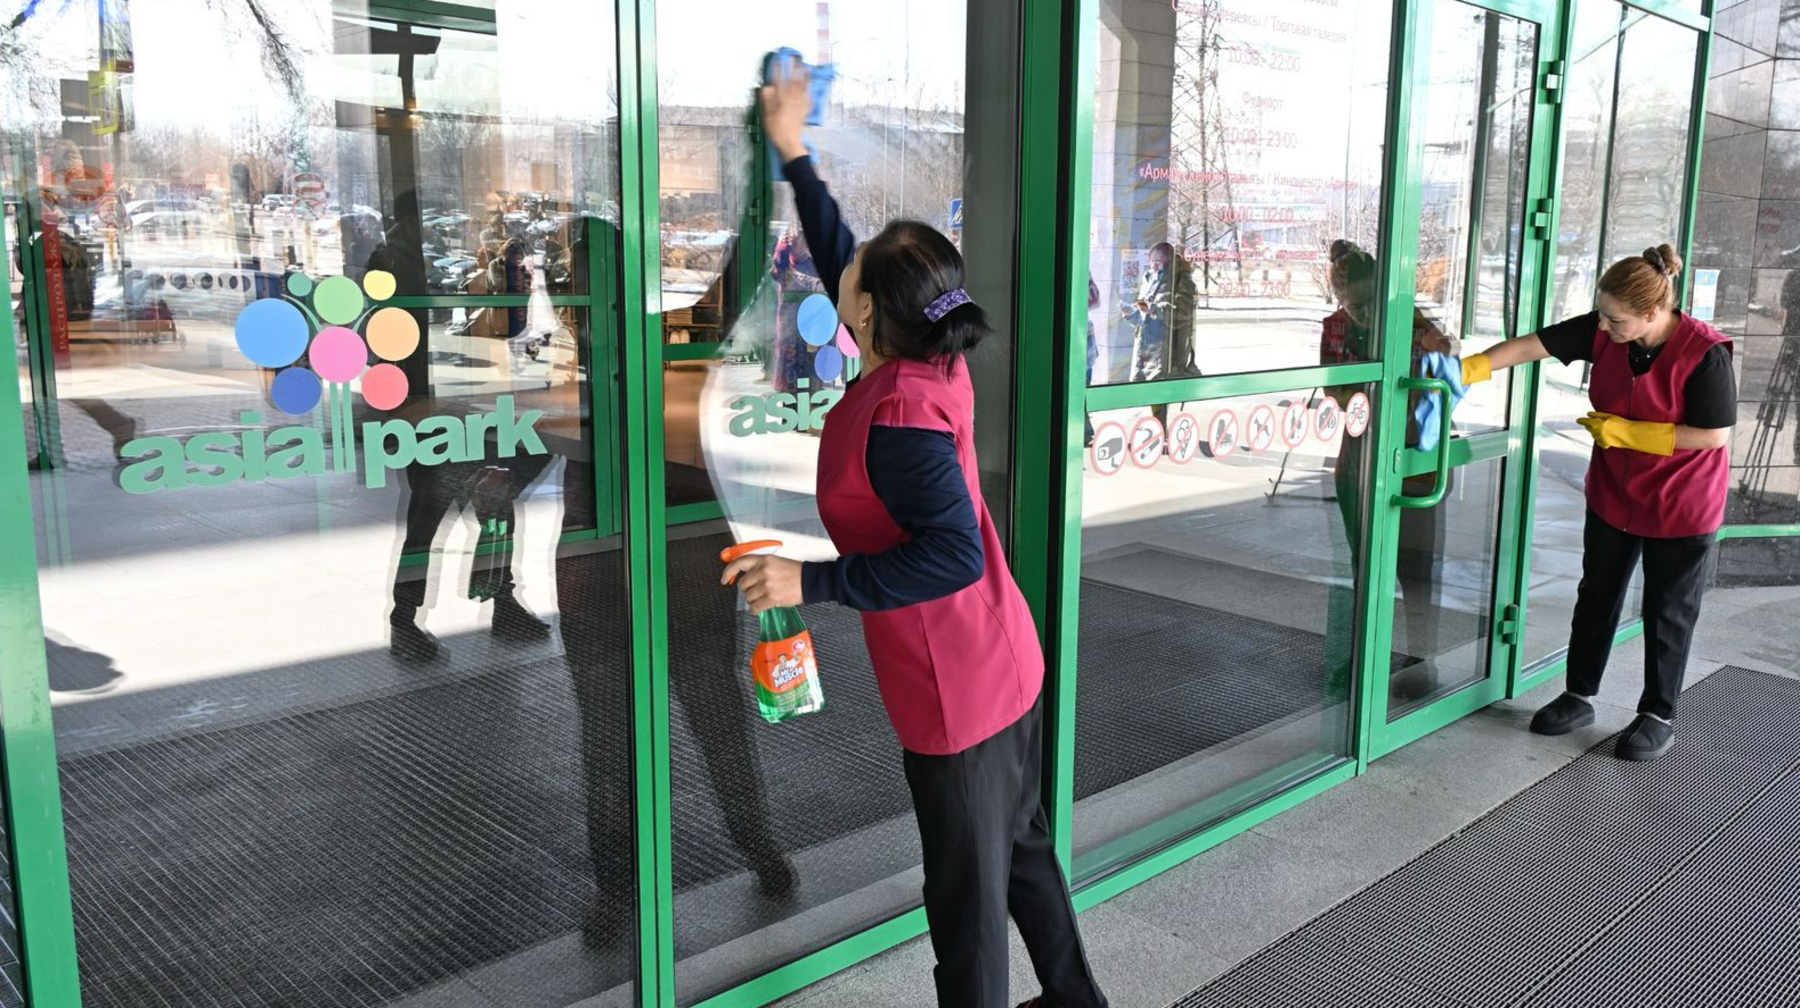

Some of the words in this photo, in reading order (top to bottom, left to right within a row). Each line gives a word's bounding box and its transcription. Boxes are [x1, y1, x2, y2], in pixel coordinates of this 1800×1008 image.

[1269, 53, 1301, 73] 22:00
[1242, 91, 1283, 112] Фудкорт
[1266, 129, 1297, 149] 23:00
[48, 230, 68, 351] РАСПРОДАЖА
[118, 412, 326, 495] asia
[362, 395, 549, 489] park
